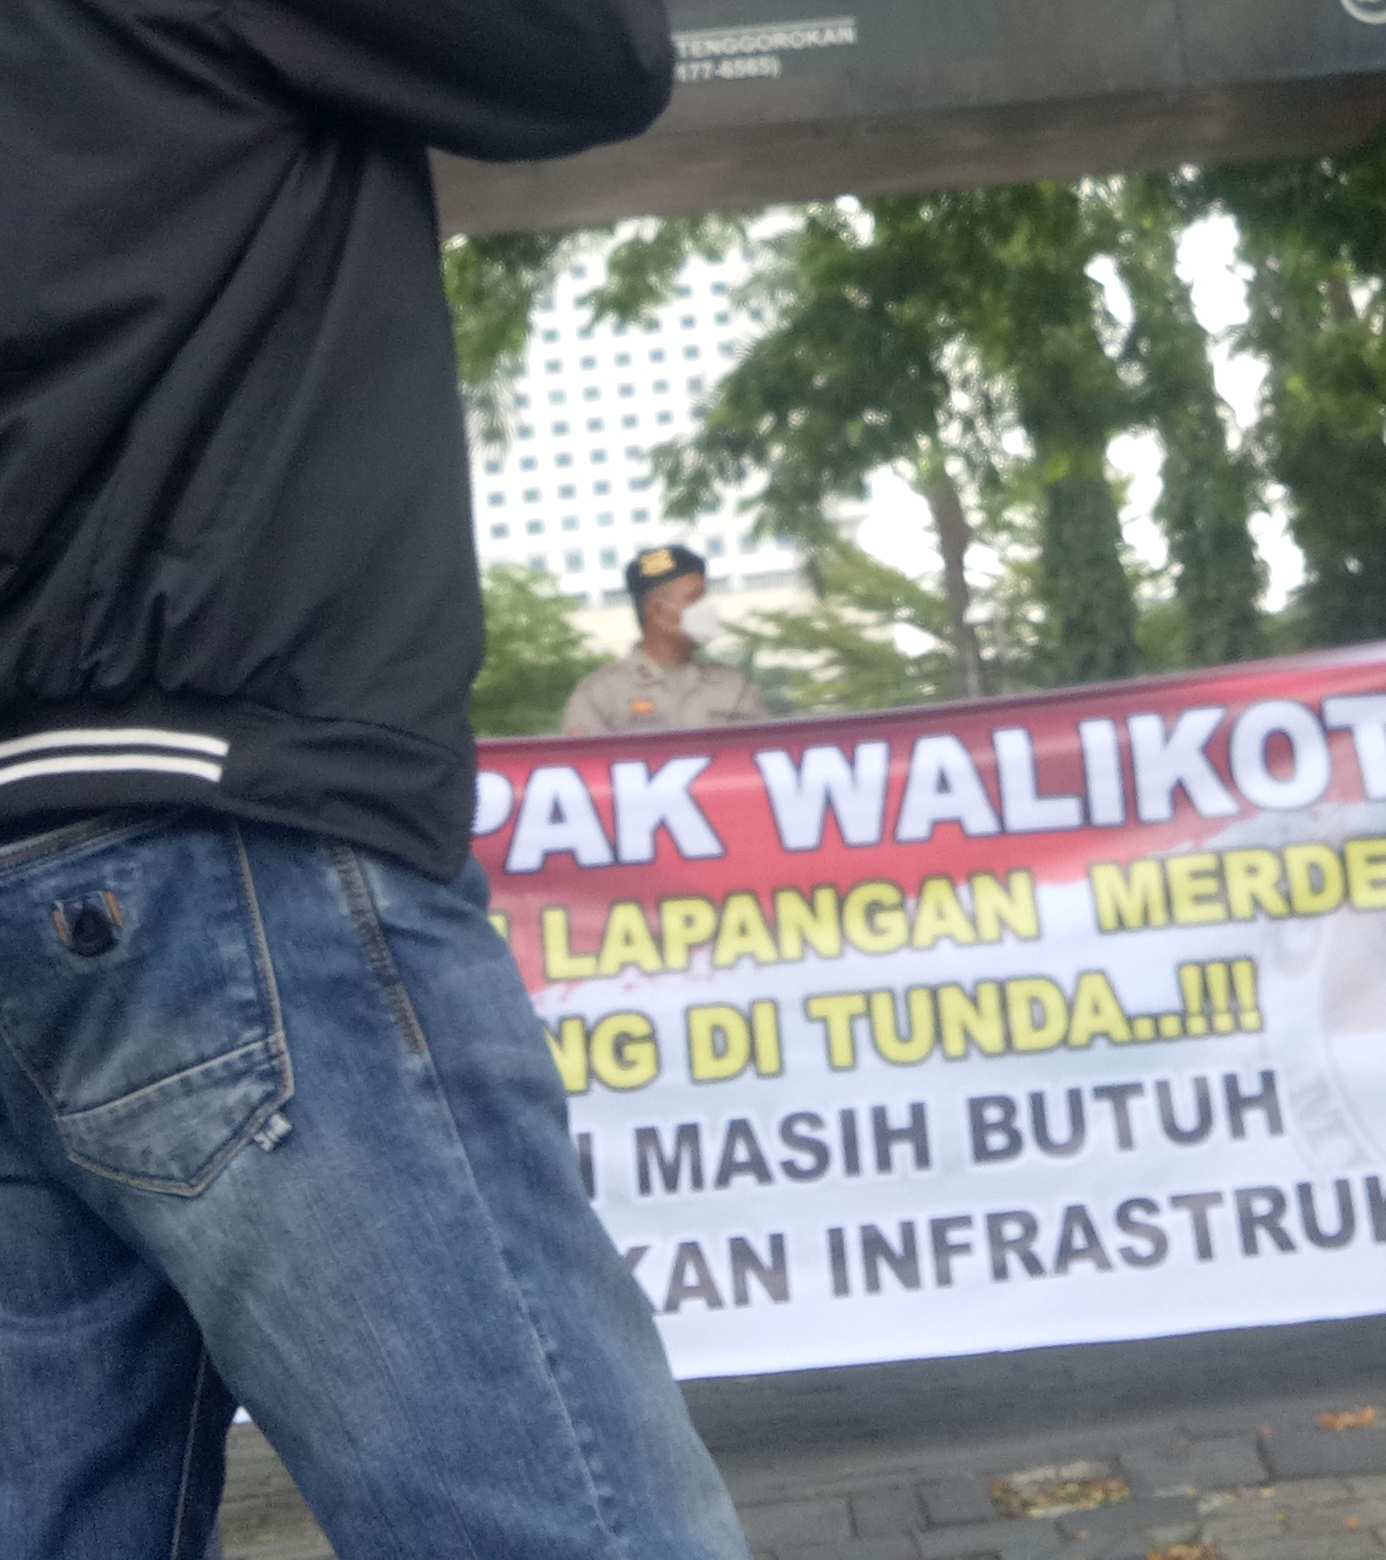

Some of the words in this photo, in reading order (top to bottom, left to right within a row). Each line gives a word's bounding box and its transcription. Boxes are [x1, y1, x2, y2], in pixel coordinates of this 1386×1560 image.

[542, 868, 1040, 981] LAPANGAN
[687, 999, 782, 1082] DI
[634, 1100, 932, 1198] MASIH
[968, 1069, 1285, 1165] BUTUH
